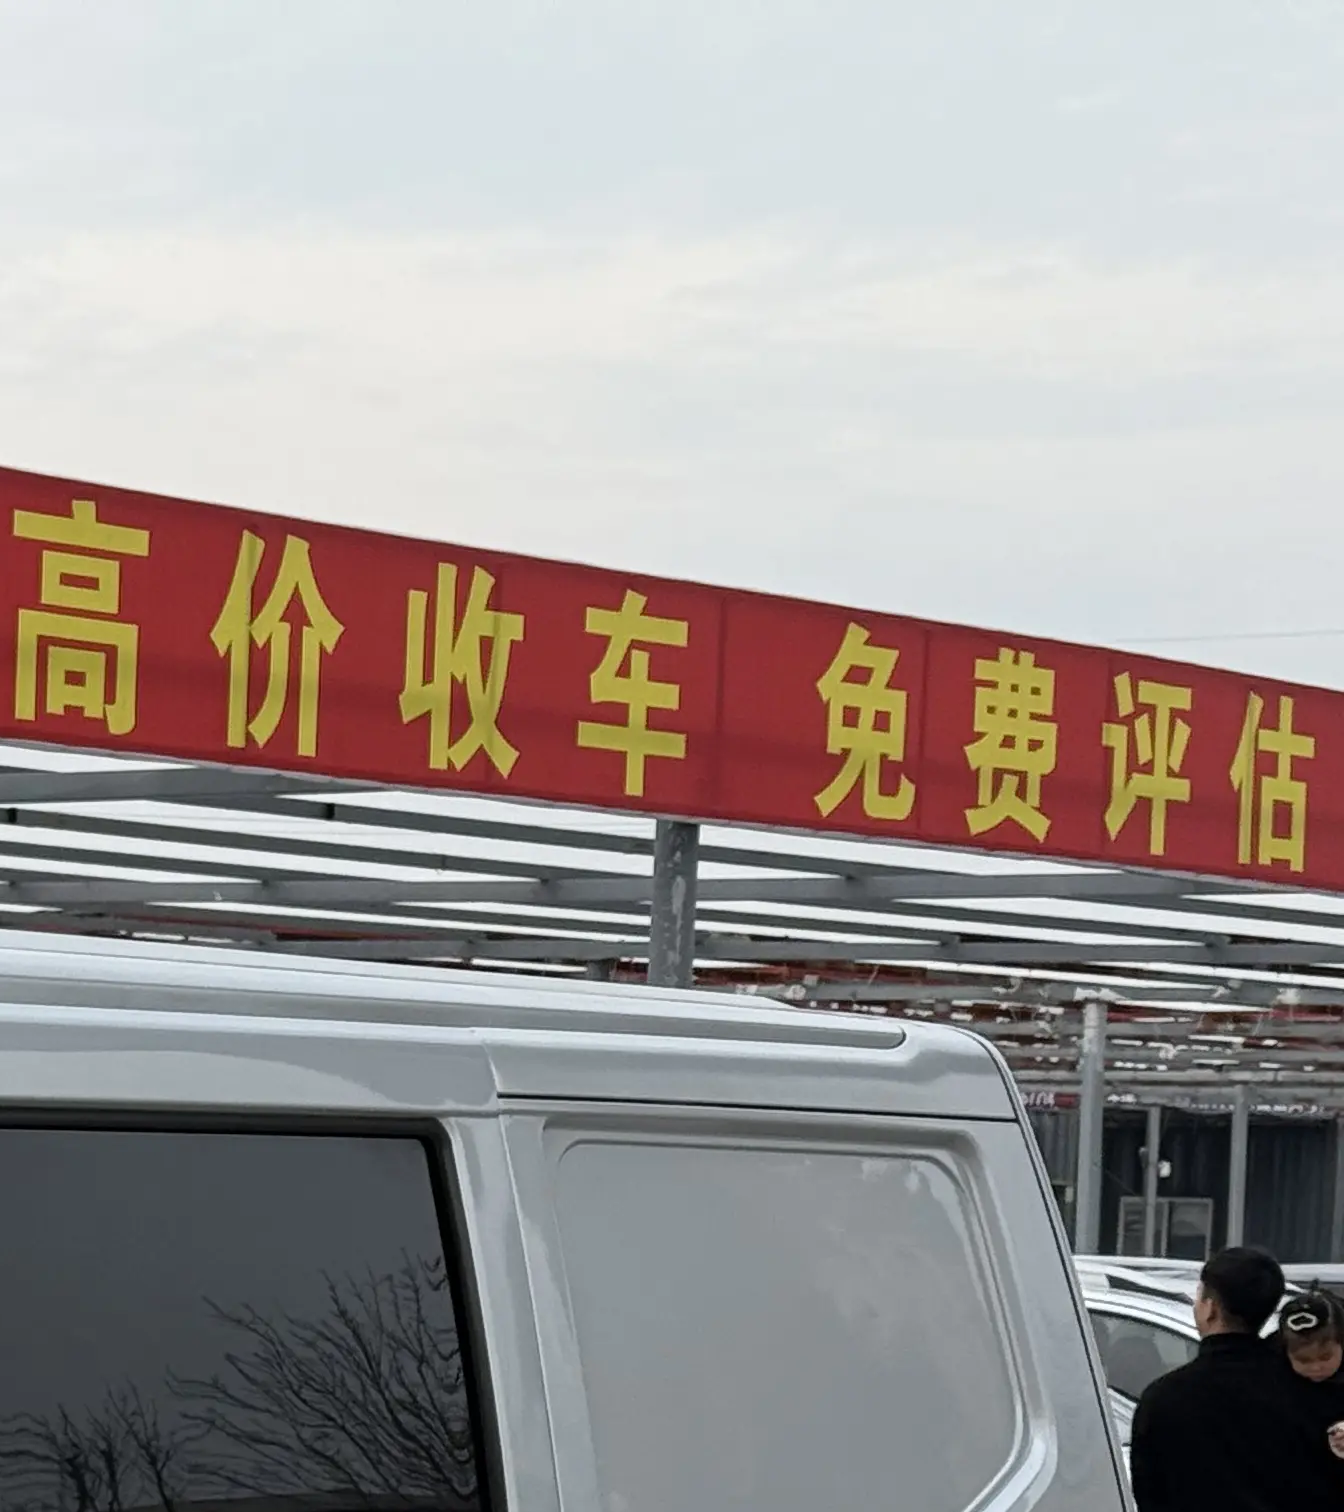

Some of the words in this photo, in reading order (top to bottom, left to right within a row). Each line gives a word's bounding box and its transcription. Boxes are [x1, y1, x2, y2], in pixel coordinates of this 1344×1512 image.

[13, 500, 690, 797] 高价收车
[814, 622, 1316, 873] 免费评估
